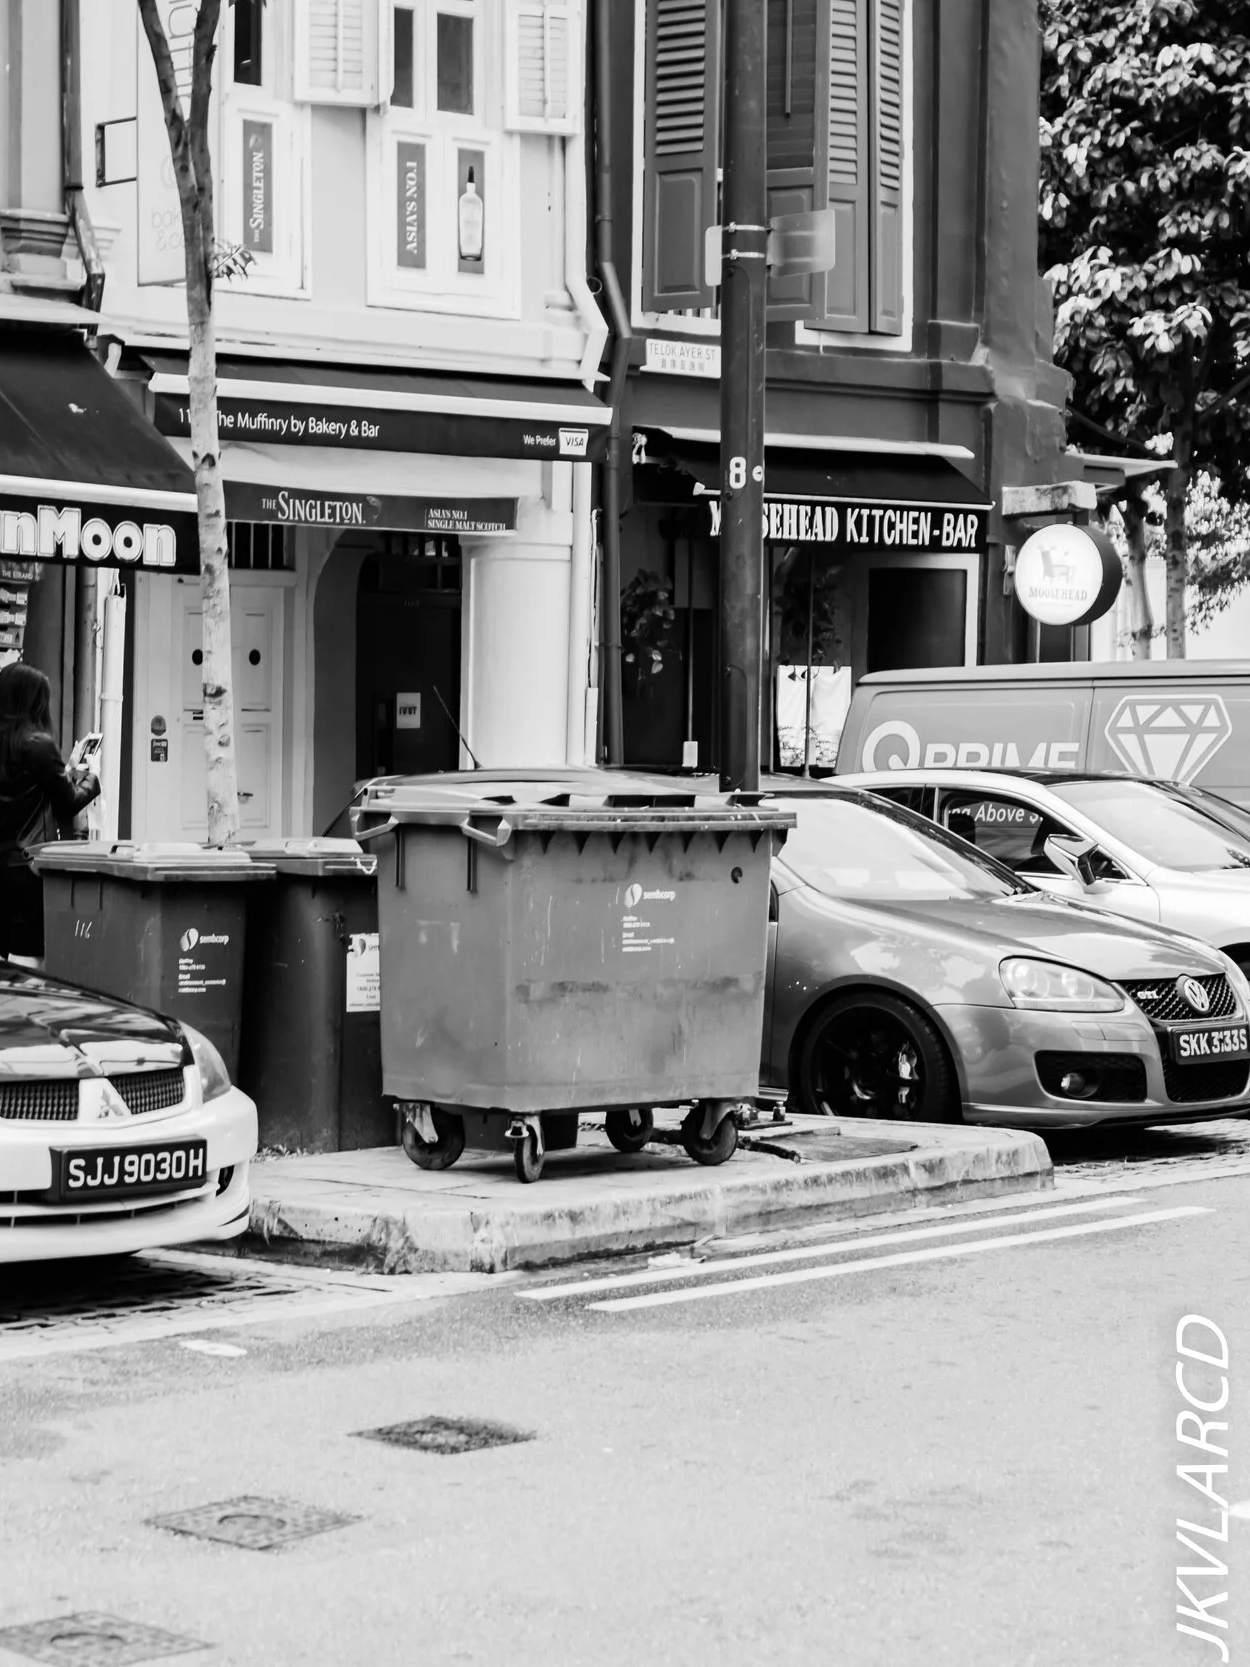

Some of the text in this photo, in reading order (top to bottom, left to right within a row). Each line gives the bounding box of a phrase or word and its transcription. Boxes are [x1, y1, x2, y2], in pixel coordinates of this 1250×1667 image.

[405, 201, 418, 255] ASIA'S
[650, 342, 716, 361] TELOK AYER ST
[237, 412, 288, 435] Muffinry
[291, 416, 305, 436] by
[308, 417, 348, 439] Bakery
[350, 420, 359, 437] &
[361, 421, 380, 438] Bar
[523, 434, 556, 447] We Prefer
[565, 436, 584, 447] VISA
[729, 456, 747, 490] 8
[262, 498, 277, 510] THE
[428, 508, 451, 519] ASIA'S
[427, 519, 506, 532] SINGLE MALT SCOTCH
[974, 803, 1025, 822] Above
